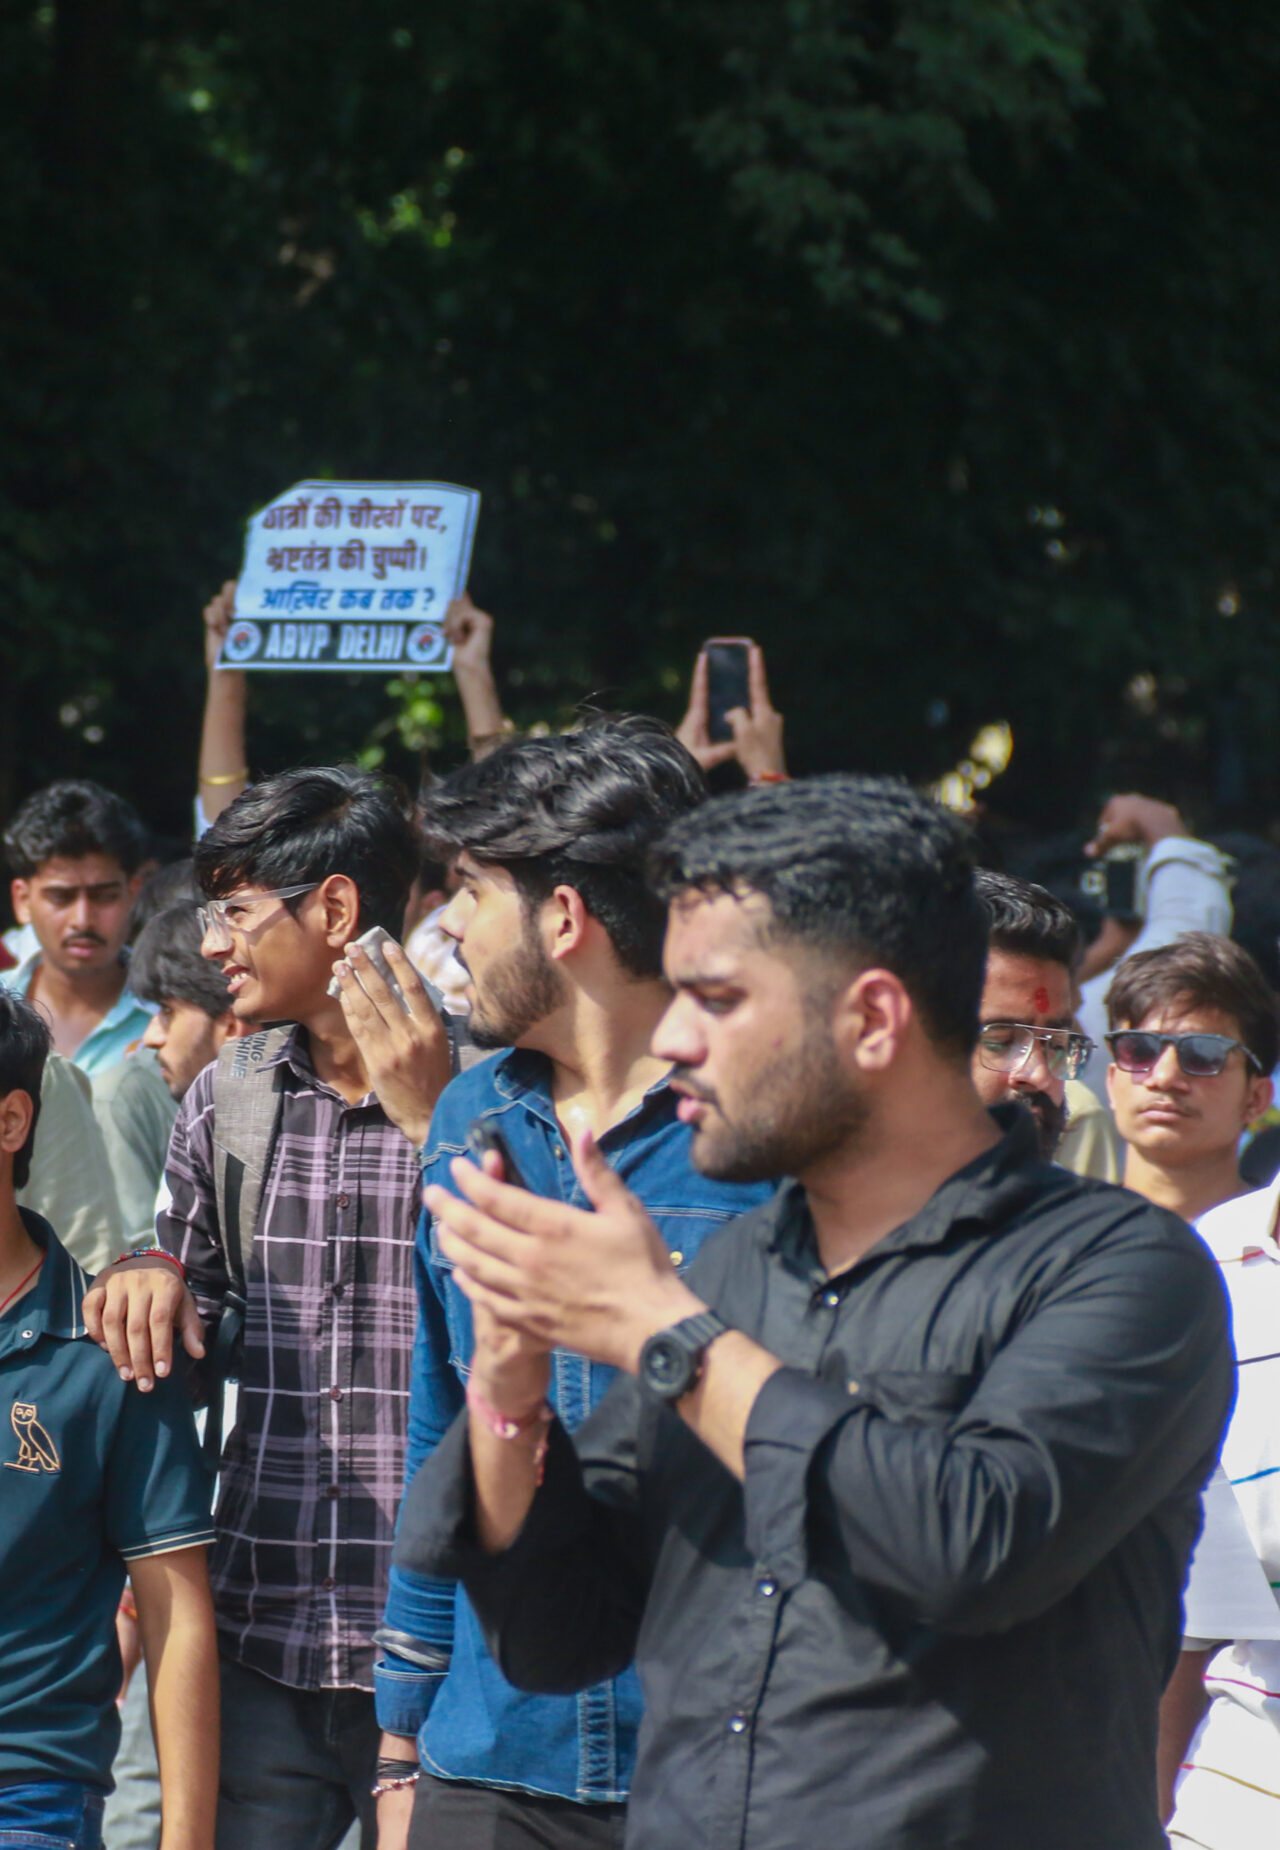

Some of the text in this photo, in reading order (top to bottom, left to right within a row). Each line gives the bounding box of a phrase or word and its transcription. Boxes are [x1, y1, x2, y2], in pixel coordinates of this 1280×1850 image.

[314, 496, 343, 528] की
[347, 497, 408, 529] चीखों
[410, 504, 447, 533] पर,
[337, 538, 366, 570] की
[339, 589, 375, 611] कब
[380, 589, 417, 611] तक
[264, 622, 407, 661] ABVP DELHI
